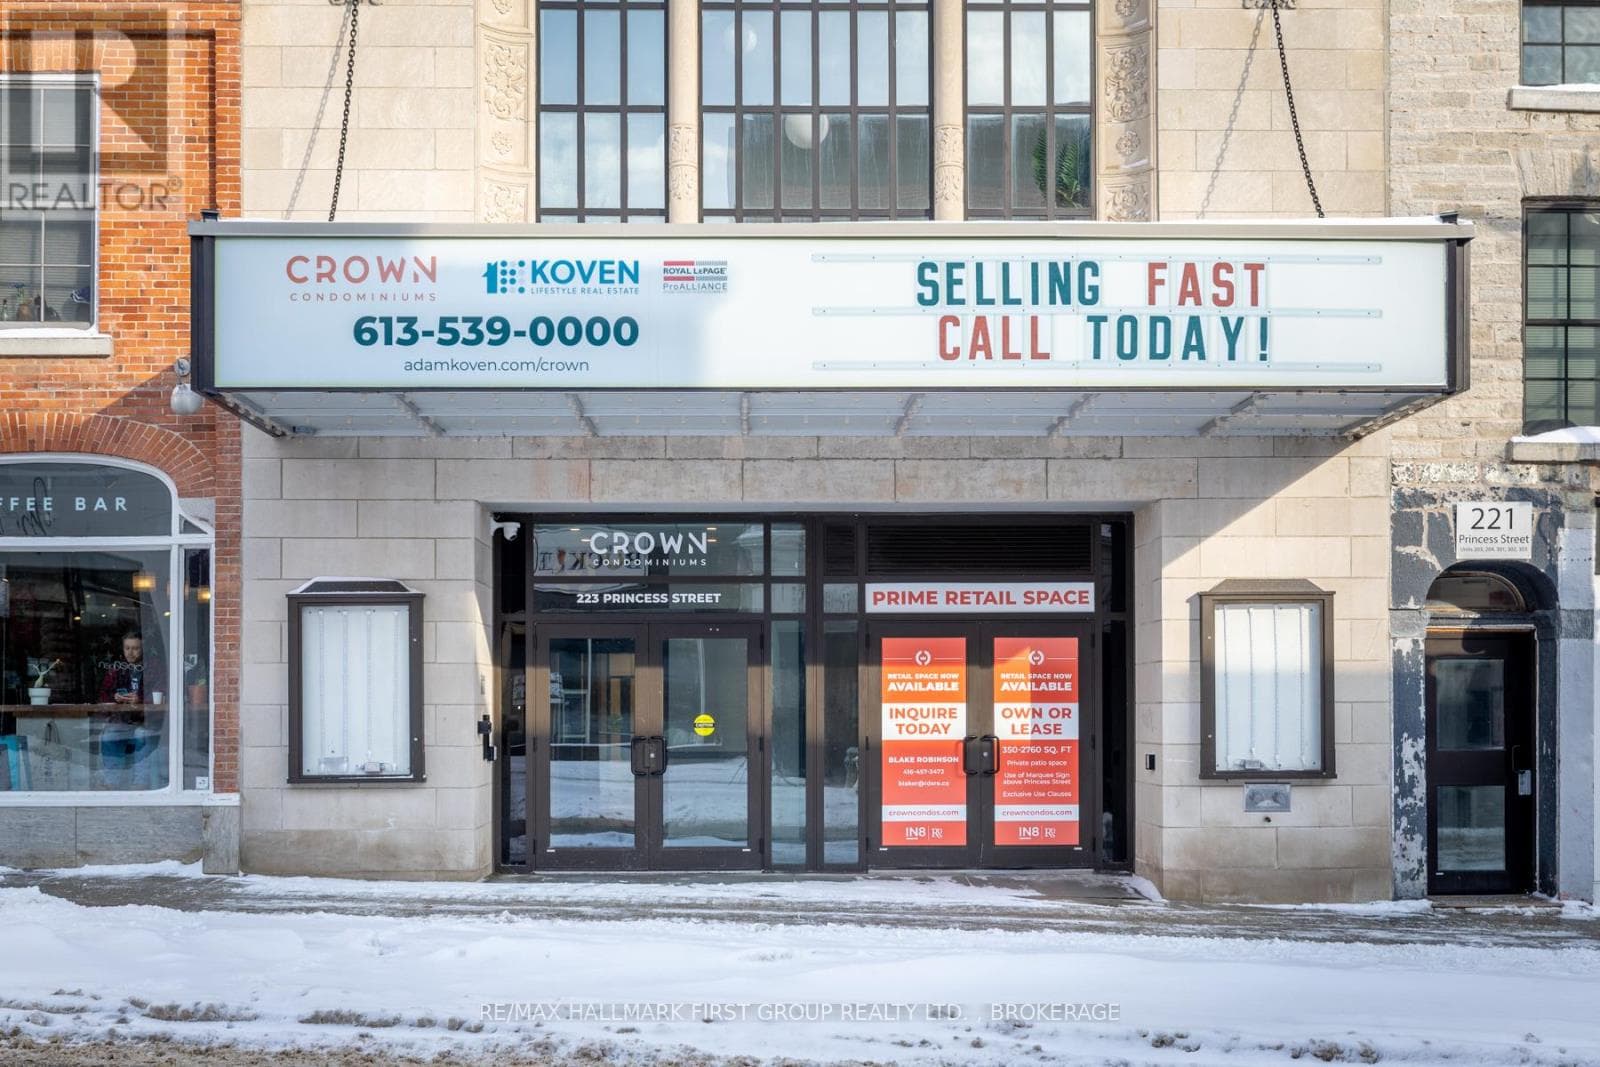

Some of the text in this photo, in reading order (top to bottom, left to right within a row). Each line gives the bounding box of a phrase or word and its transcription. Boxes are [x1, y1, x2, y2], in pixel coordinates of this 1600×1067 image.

[286, 255, 437, 284] CROWN
[531, 260, 640, 285] KOVEN
[663, 267, 691, 275] ROYAL
[663, 282, 728, 291] ProALLIANCE
[917, 261, 1265, 307] SELLING FAST
[531, 287, 640, 295] LIFESTYLE REAL ESTATE
[290, 293, 436, 301] CONDOMINIUMS
[353, 316, 640, 347] 613-539-0000
[938, 315, 1269, 362] CALL TODAY!
[404, 357, 590, 373] adamkoven.com/crown
[0, 496, 128, 512] FEE BAR
[1470, 507, 1513, 530] 221
[590, 532, 707, 555] CROWN
[1459, 534, 1530, 545] Princess Street
[593, 558, 707, 567] CONDOMINIUMS
[577, 593, 721, 604] 223 PRINCESS STREET
[873, 590, 1090, 605] PRIME RETAIL SPACE
[888, 682, 959, 691] AVAILABLE
[1001, 682, 1072, 691] AVAILABLE
[890, 708, 957, 721] INQUIRE
[1001, 708, 1072, 719] OWN OR
[896, 723, 951, 734] TODAY
[1011, 723, 1062, 734] LEASE
[1043, 746, 1058, 754] SQ.
[888, 809, 959, 817] crowncondos.com
[905, 827, 926, 837] IN8
[1018, 826, 1040, 837] IN8
